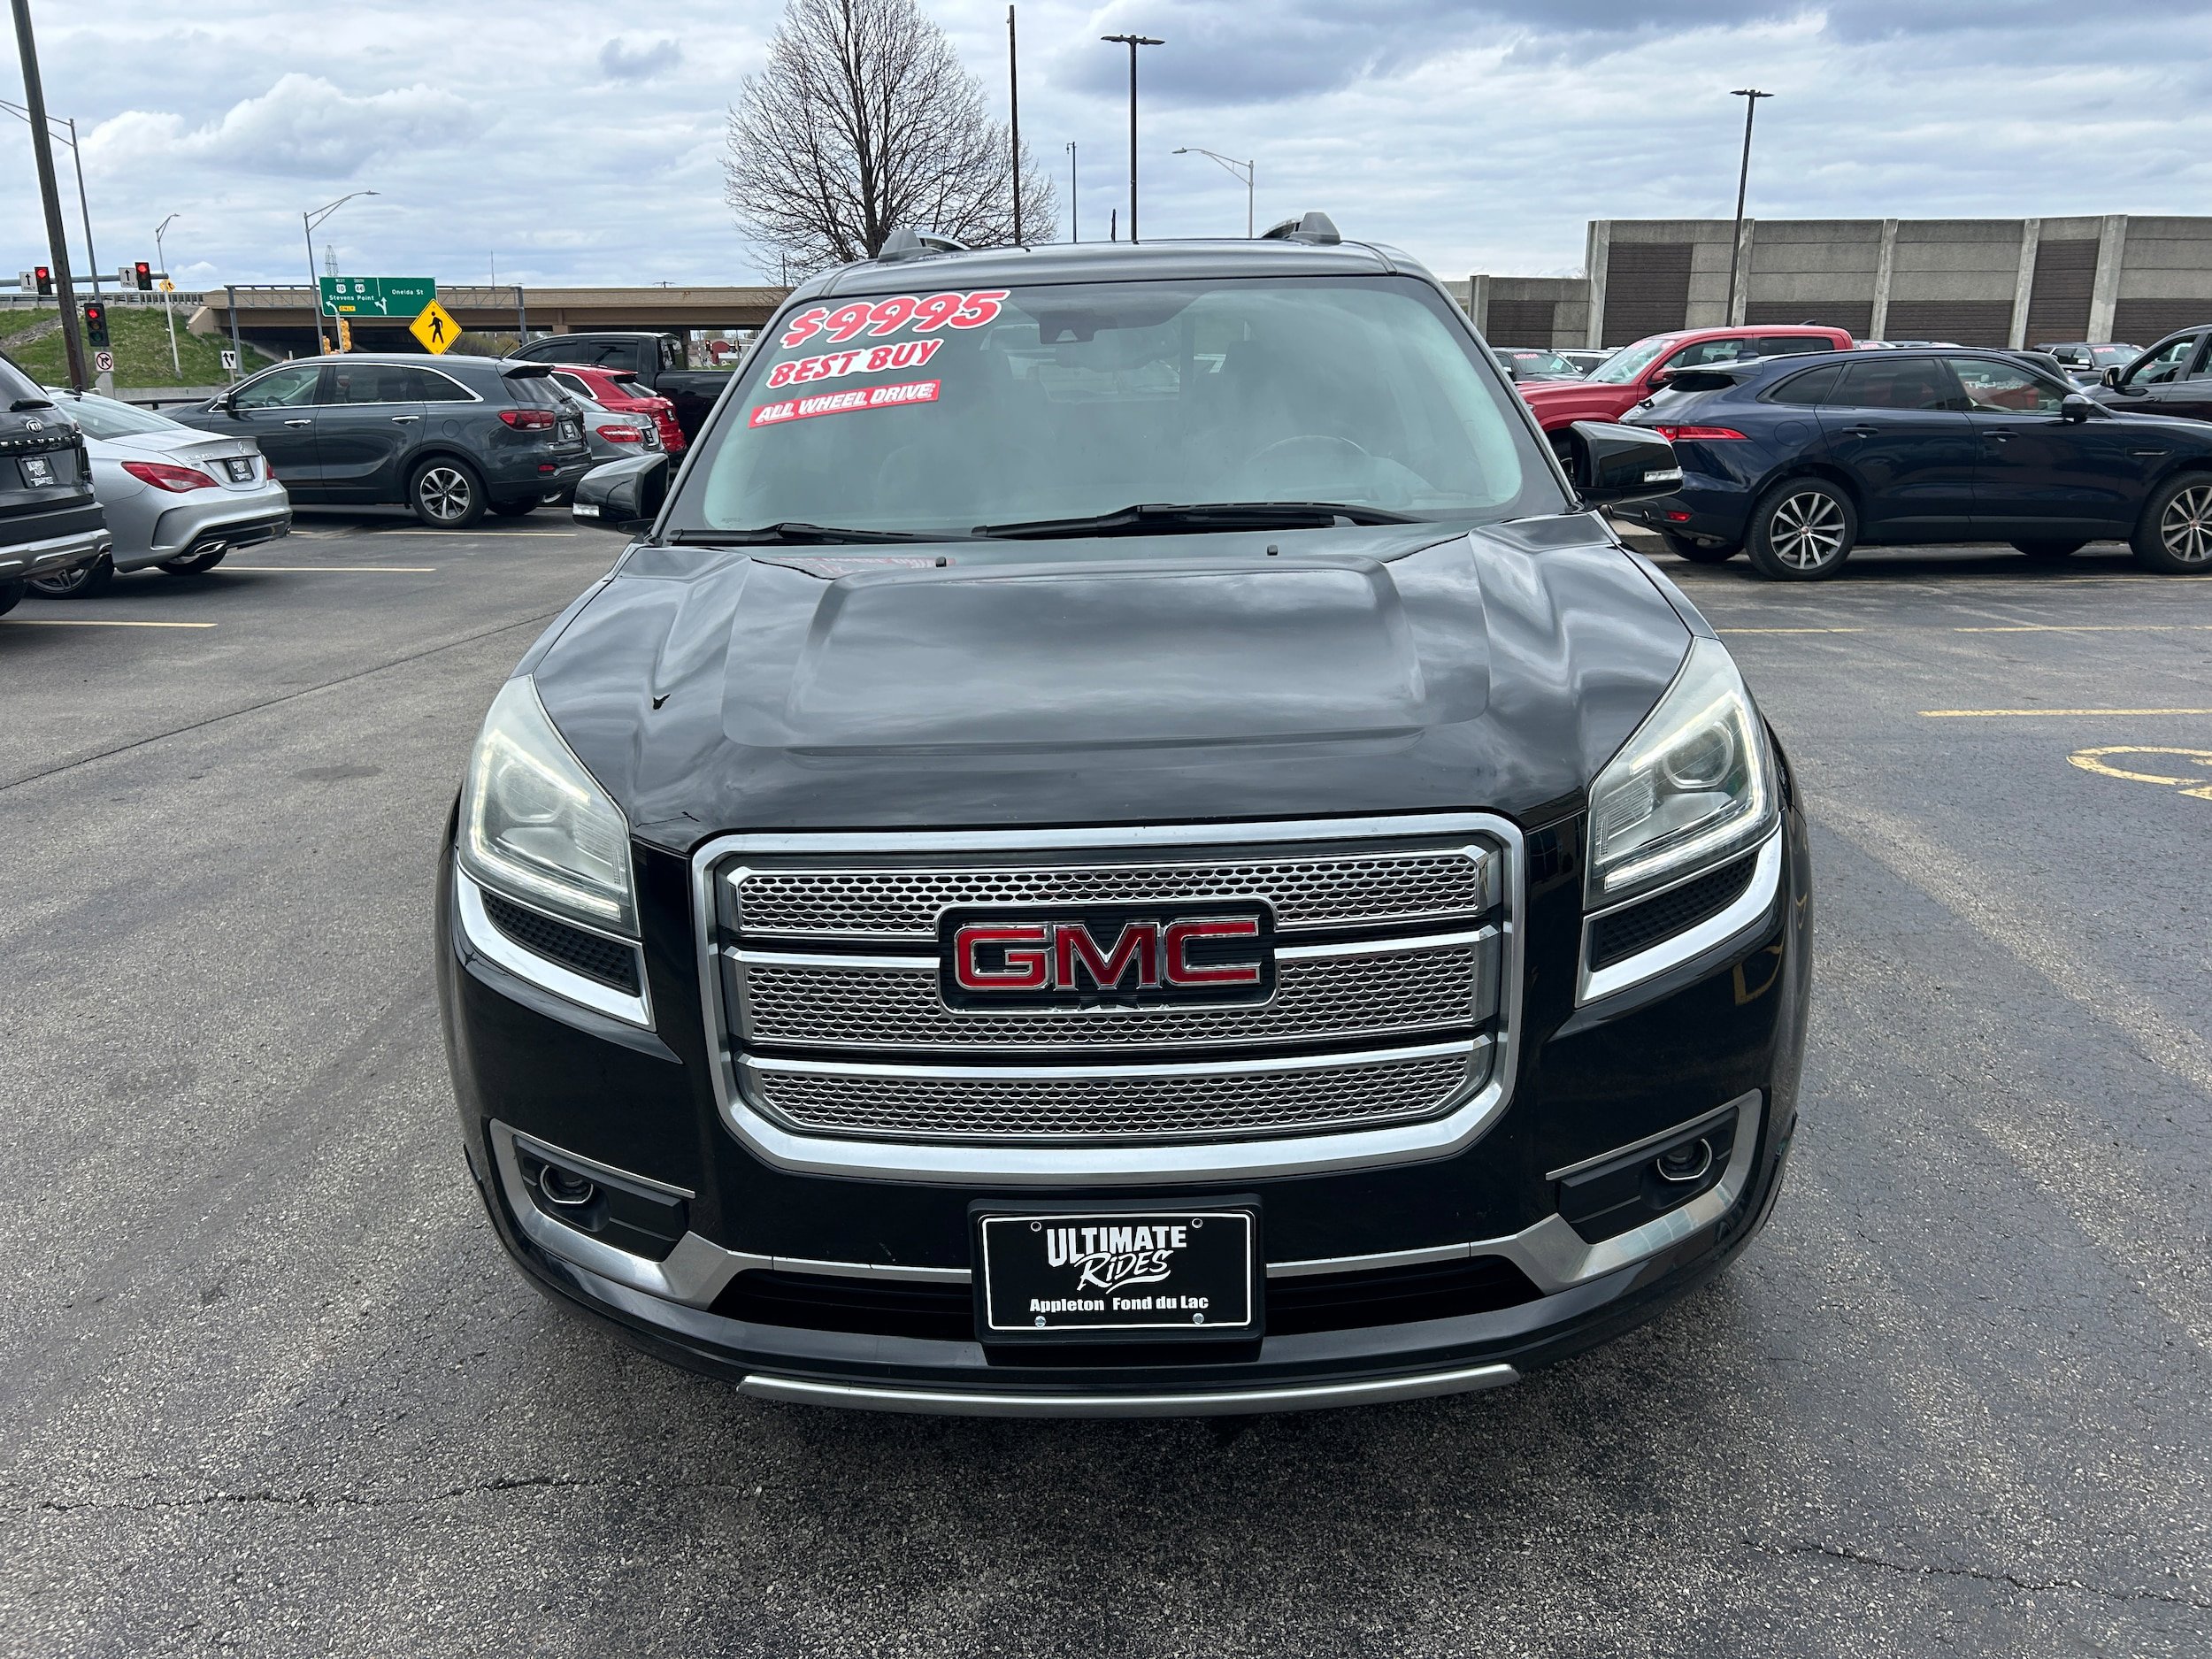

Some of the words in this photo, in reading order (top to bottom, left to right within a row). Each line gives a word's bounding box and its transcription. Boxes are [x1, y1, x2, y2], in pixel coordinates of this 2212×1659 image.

[780, 290, 1010, 349] $9995
[766, 349, 861, 388] BEST
[867, 339, 943, 370] BUY
[756, 403, 795, 424] ALL
[799, 392, 867, 415] WHEEL
[870, 382, 935, 404] DRIVE
[954, 915, 1261, 991] GMC
[1047, 1225, 1187, 1268] ULTIMATE
[1030, 1298, 1105, 1313] Appleton
[1113, 1296, 1152, 1310] Fond
[1156, 1296, 1177, 1310] du
[1180, 1295, 1209, 1310] Lac
